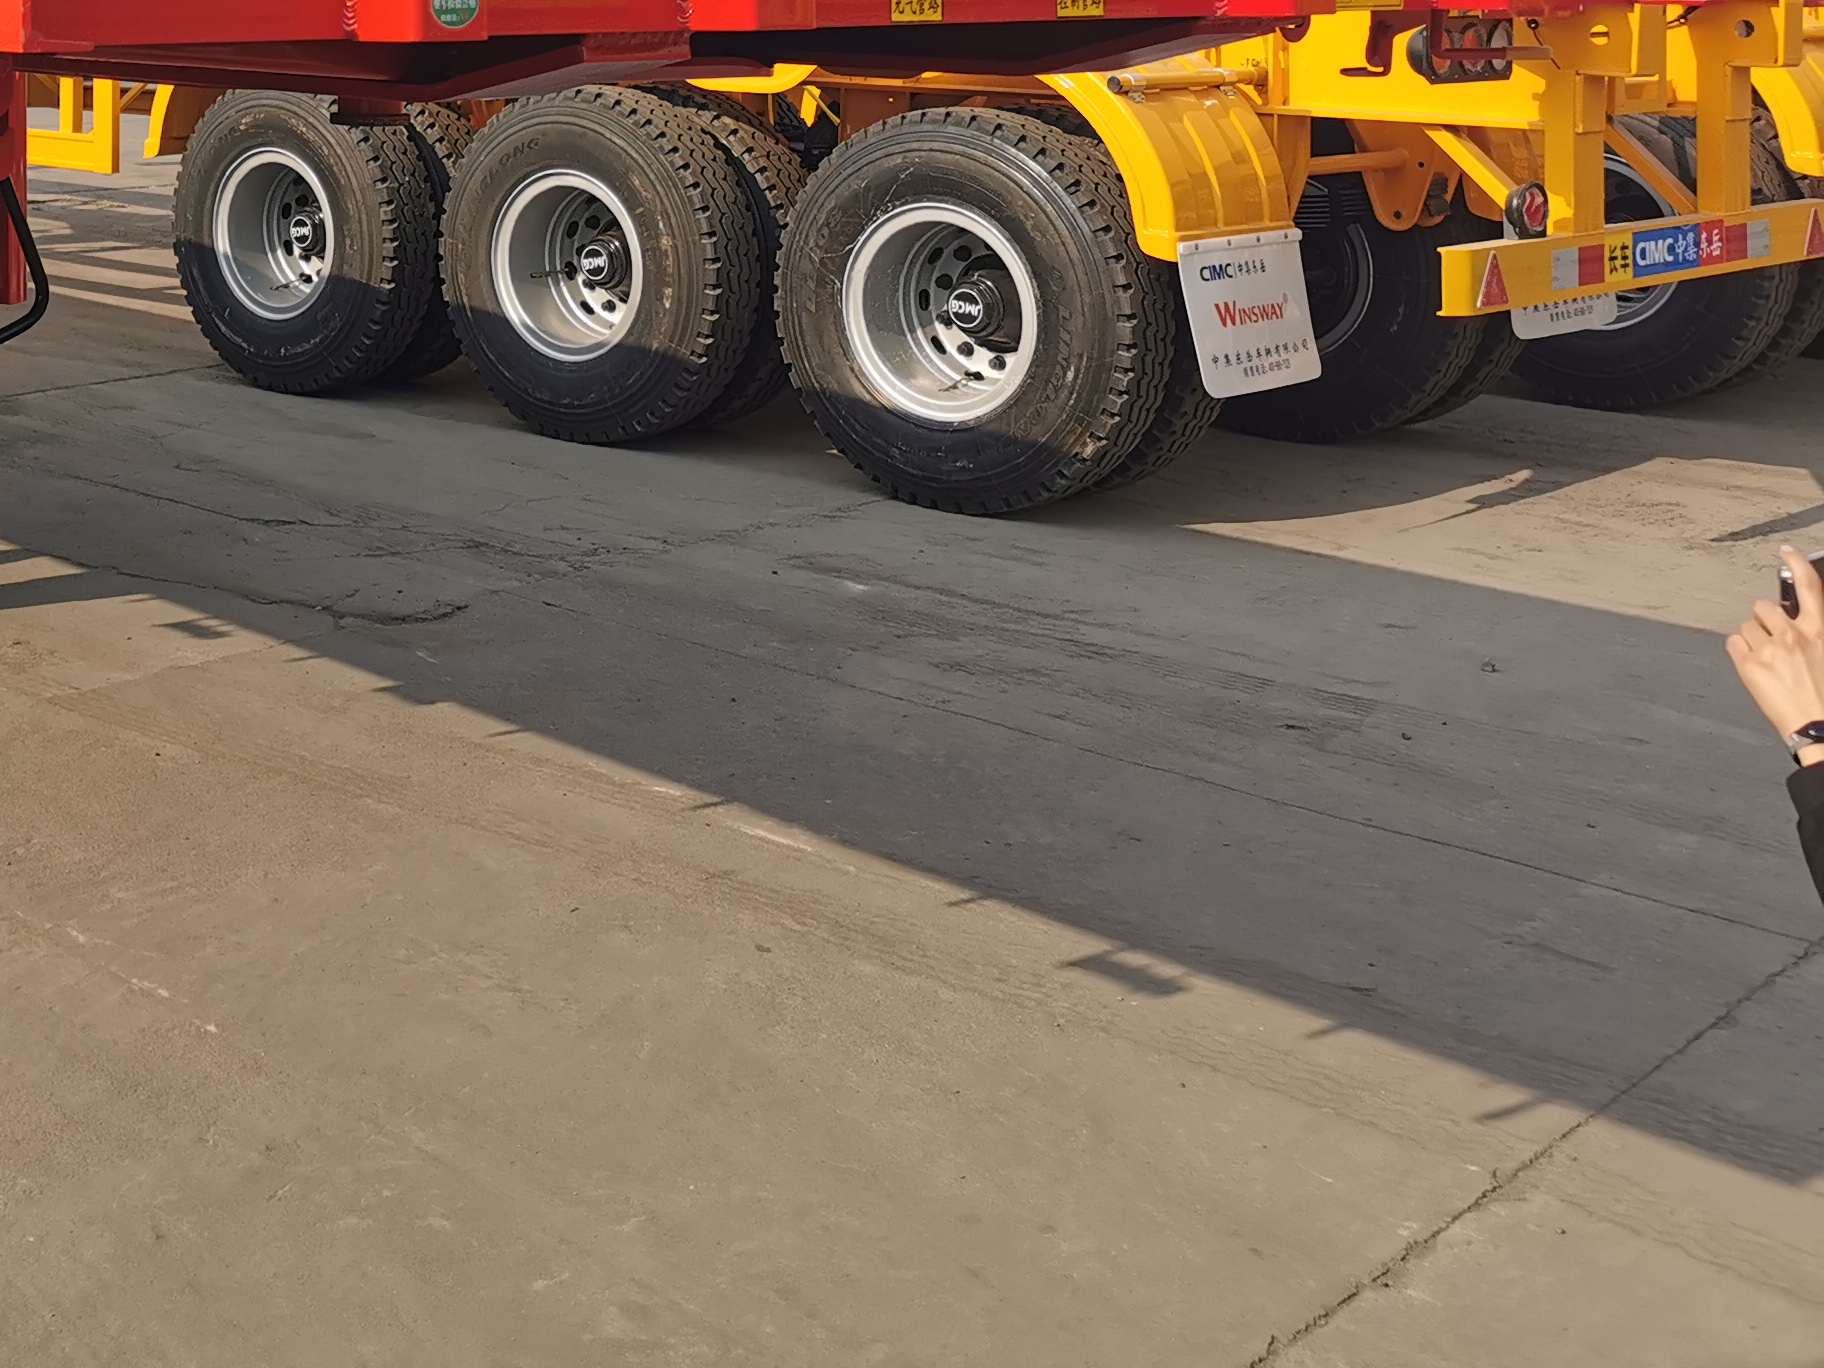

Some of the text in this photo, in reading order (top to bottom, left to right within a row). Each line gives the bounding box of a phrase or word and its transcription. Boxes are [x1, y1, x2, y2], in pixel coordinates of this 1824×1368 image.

[1636, 228, 1723, 267] CIMC 中集东岳
[1200, 262, 1233, 282] CIMC
[951, 299, 980, 316] JMCG
